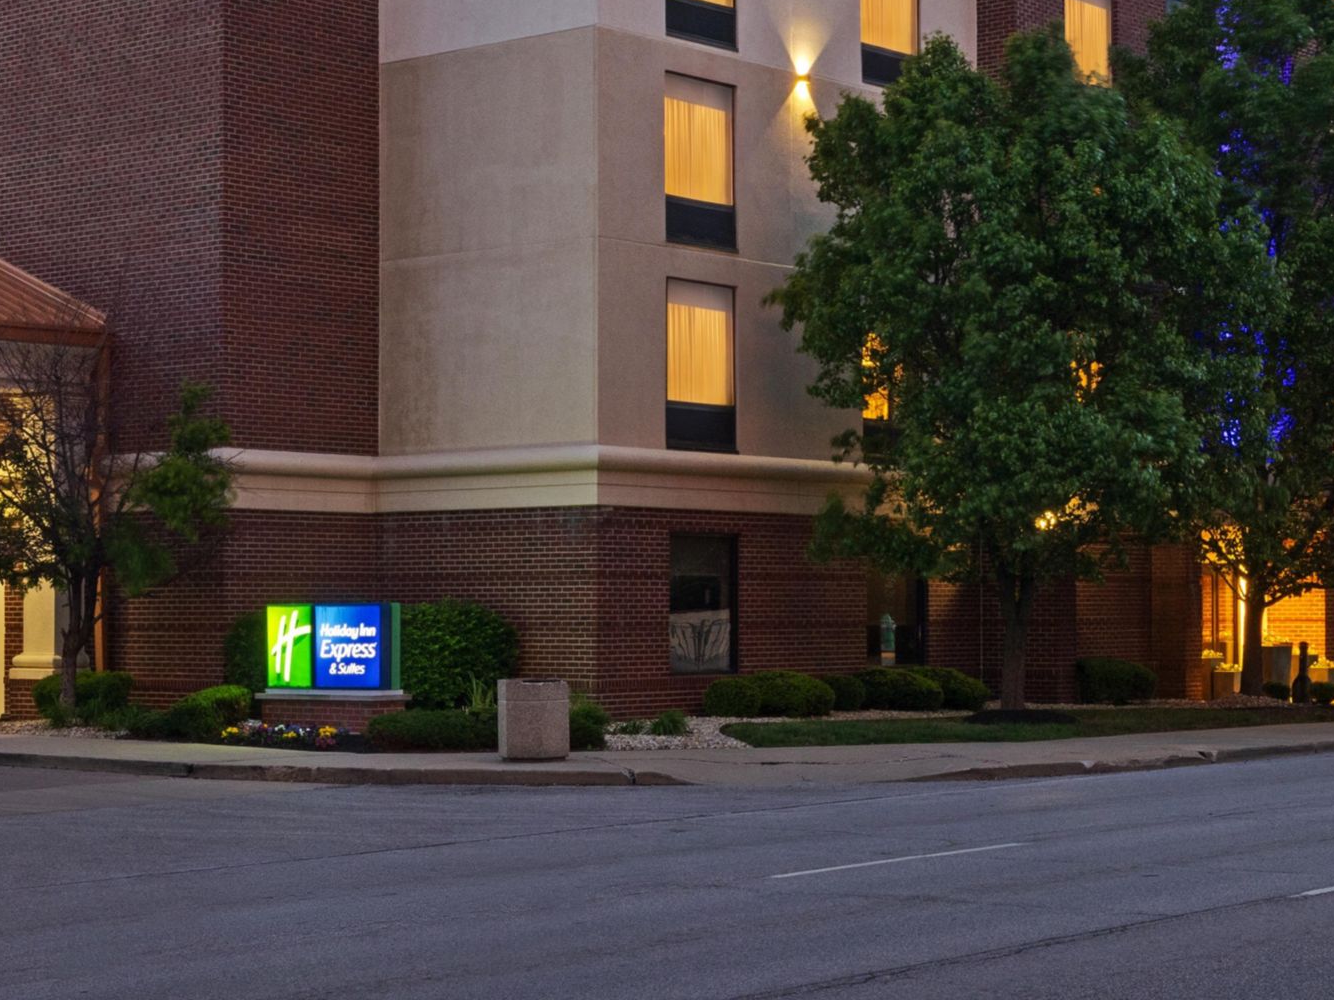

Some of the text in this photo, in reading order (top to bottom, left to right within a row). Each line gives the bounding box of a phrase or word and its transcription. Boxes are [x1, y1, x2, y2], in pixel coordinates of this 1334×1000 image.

[320, 622, 377, 640] Holiday Inn
[320, 639, 377, 662] Express
[329, 662, 366, 675] & Suites
